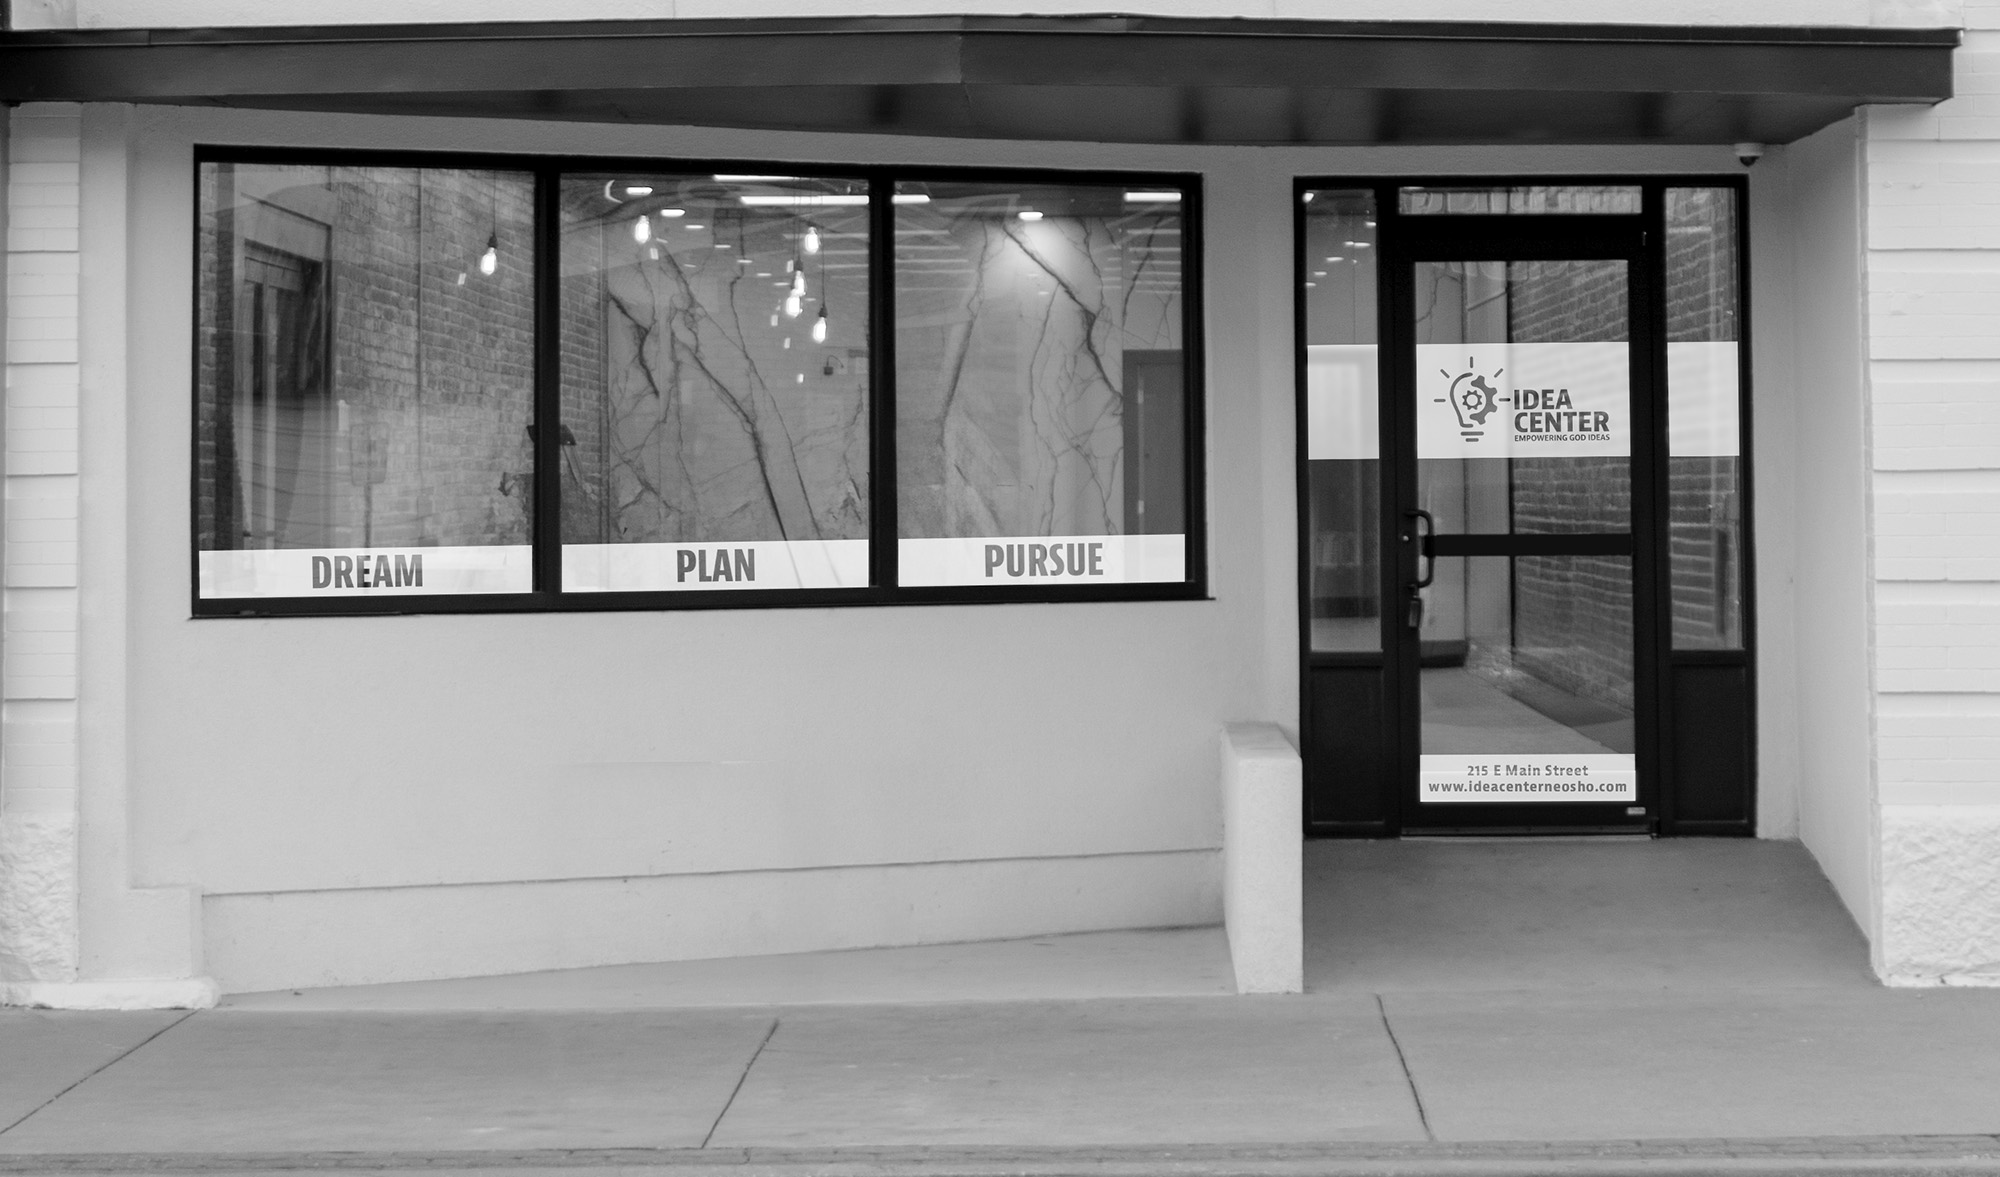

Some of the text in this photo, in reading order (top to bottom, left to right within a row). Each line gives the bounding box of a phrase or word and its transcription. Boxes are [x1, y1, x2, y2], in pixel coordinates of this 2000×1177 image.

[1513, 388, 1573, 410] IDEA
[1514, 411, 1610, 433] CENTER
[1514, 434, 1568, 442] EMPOWERING
[1588, 433, 1611, 441] IDEAS
[676, 548, 756, 583] PLAN
[984, 542, 1104, 578] PURSUE
[311, 555, 423, 589] DREAM
[1467, 764, 1589, 776] 215 E Main Street
[1428, 781, 1627, 793] www.ideacenterneosho.com
